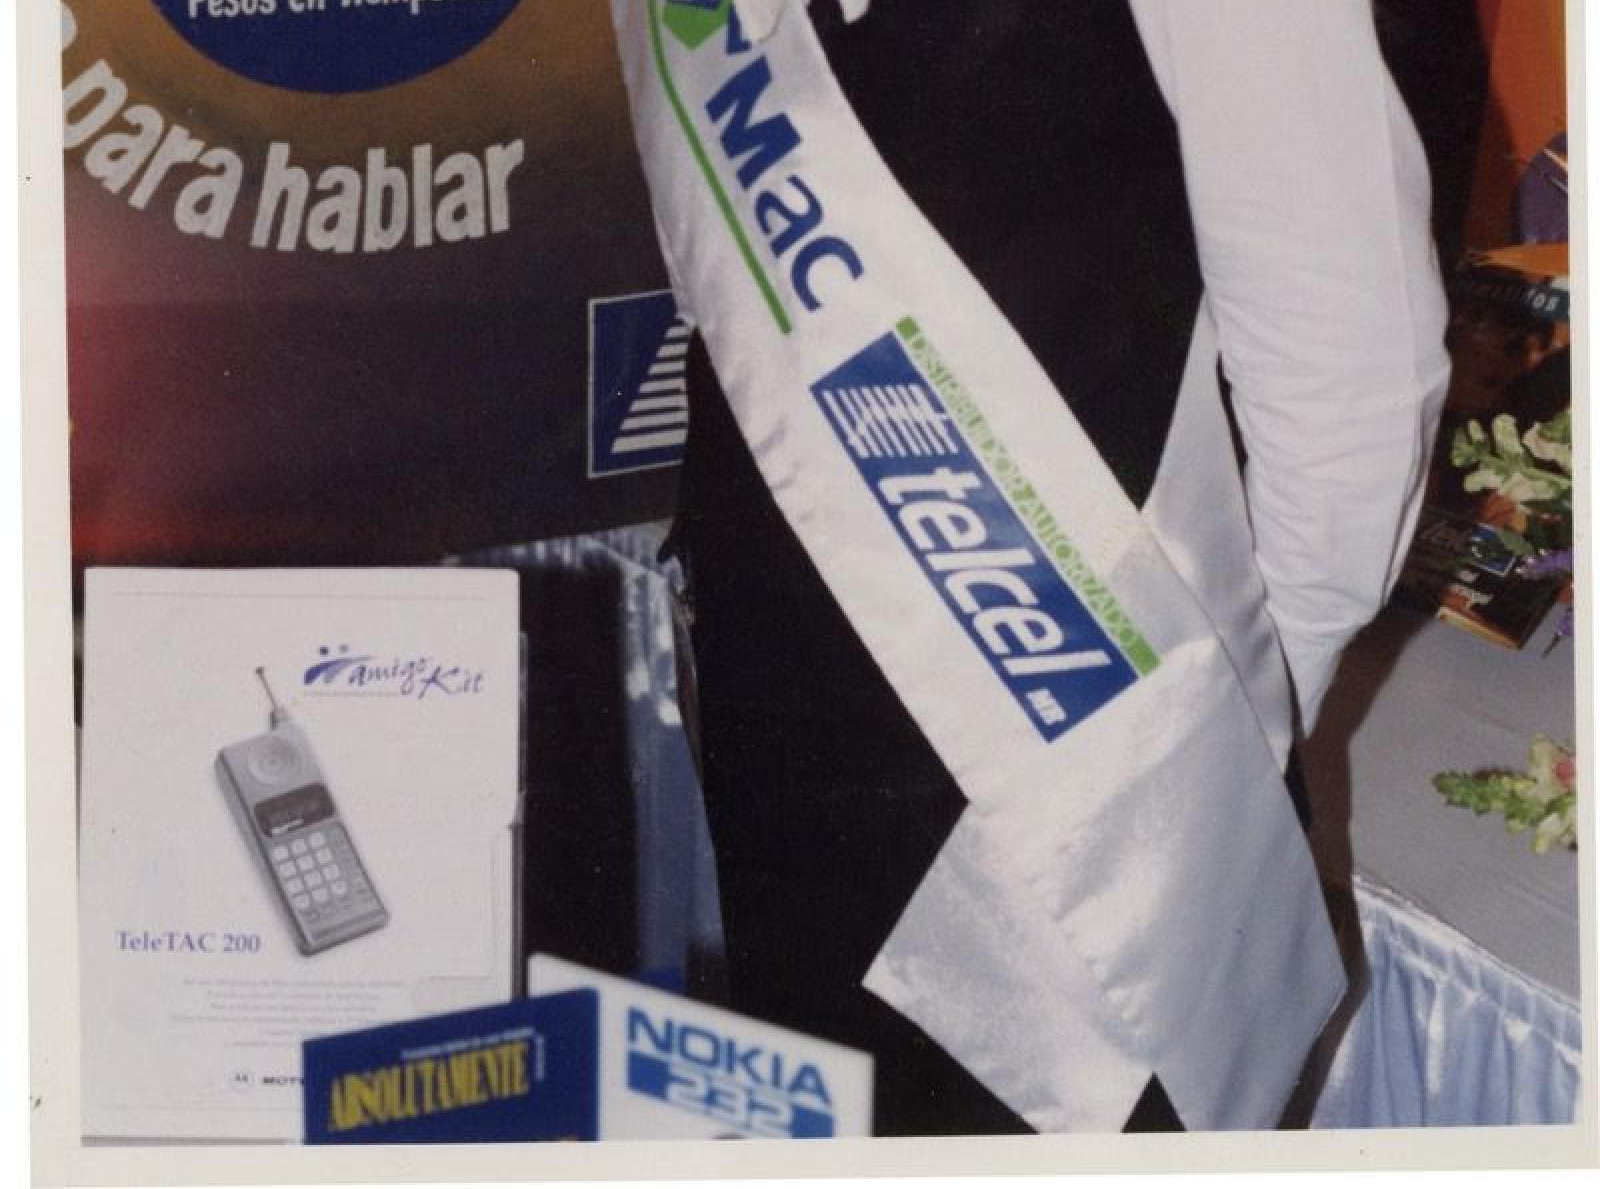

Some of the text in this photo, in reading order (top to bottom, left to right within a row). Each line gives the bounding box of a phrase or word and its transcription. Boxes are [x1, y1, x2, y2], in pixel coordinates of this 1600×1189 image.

[62, 58, 525, 254] para hablar
[878, 466, 1112, 677] telcel
[116, 929, 262, 954] TeleTAC 200
[626, 1004, 835, 1109] NOKIA
